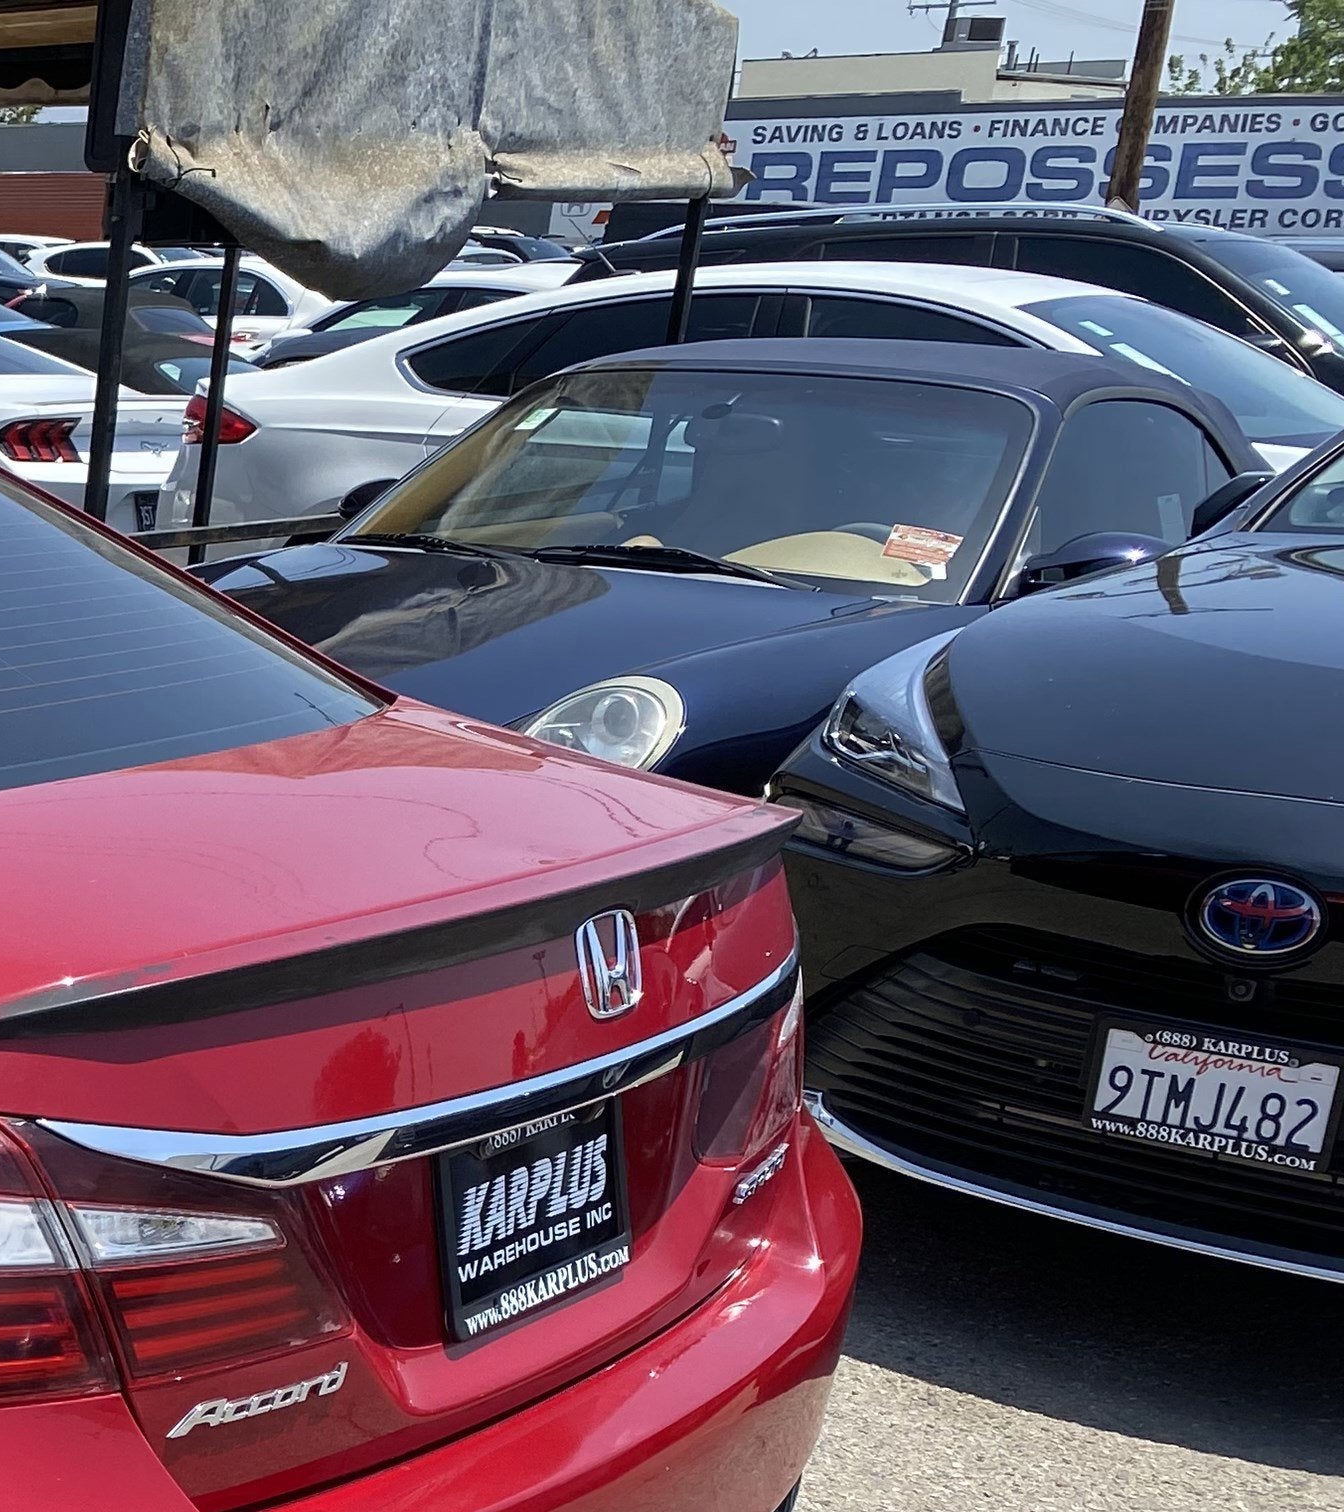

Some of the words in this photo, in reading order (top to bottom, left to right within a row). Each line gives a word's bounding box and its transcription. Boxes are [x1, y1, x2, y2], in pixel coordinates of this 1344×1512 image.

[751, 124, 845, 145] SAVING
[854, 121, 869, 141] &
[876, 120, 963, 141] LOANS
[987, 116, 1108, 138] FINANCE
[1115, 113, 1282, 136] MPANIES
[745, 140, 1344, 203] REPOSSES
[1144, 208, 1270, 229] RYSLER
[1148, 1044, 1299, 1083] California
[1155, 1030, 1197, 1047] (888)
[1202, 1037, 1291, 1063] KARPLUS
[1102, 1065, 1319, 1152] 9TMJ482
[456, 1133, 608, 1256] KARPLUS
[457, 1217, 581, 1283] WAREHOUSE
[586, 1202, 613, 1230] INC
[165, 1361, 349, 1439] Accord
